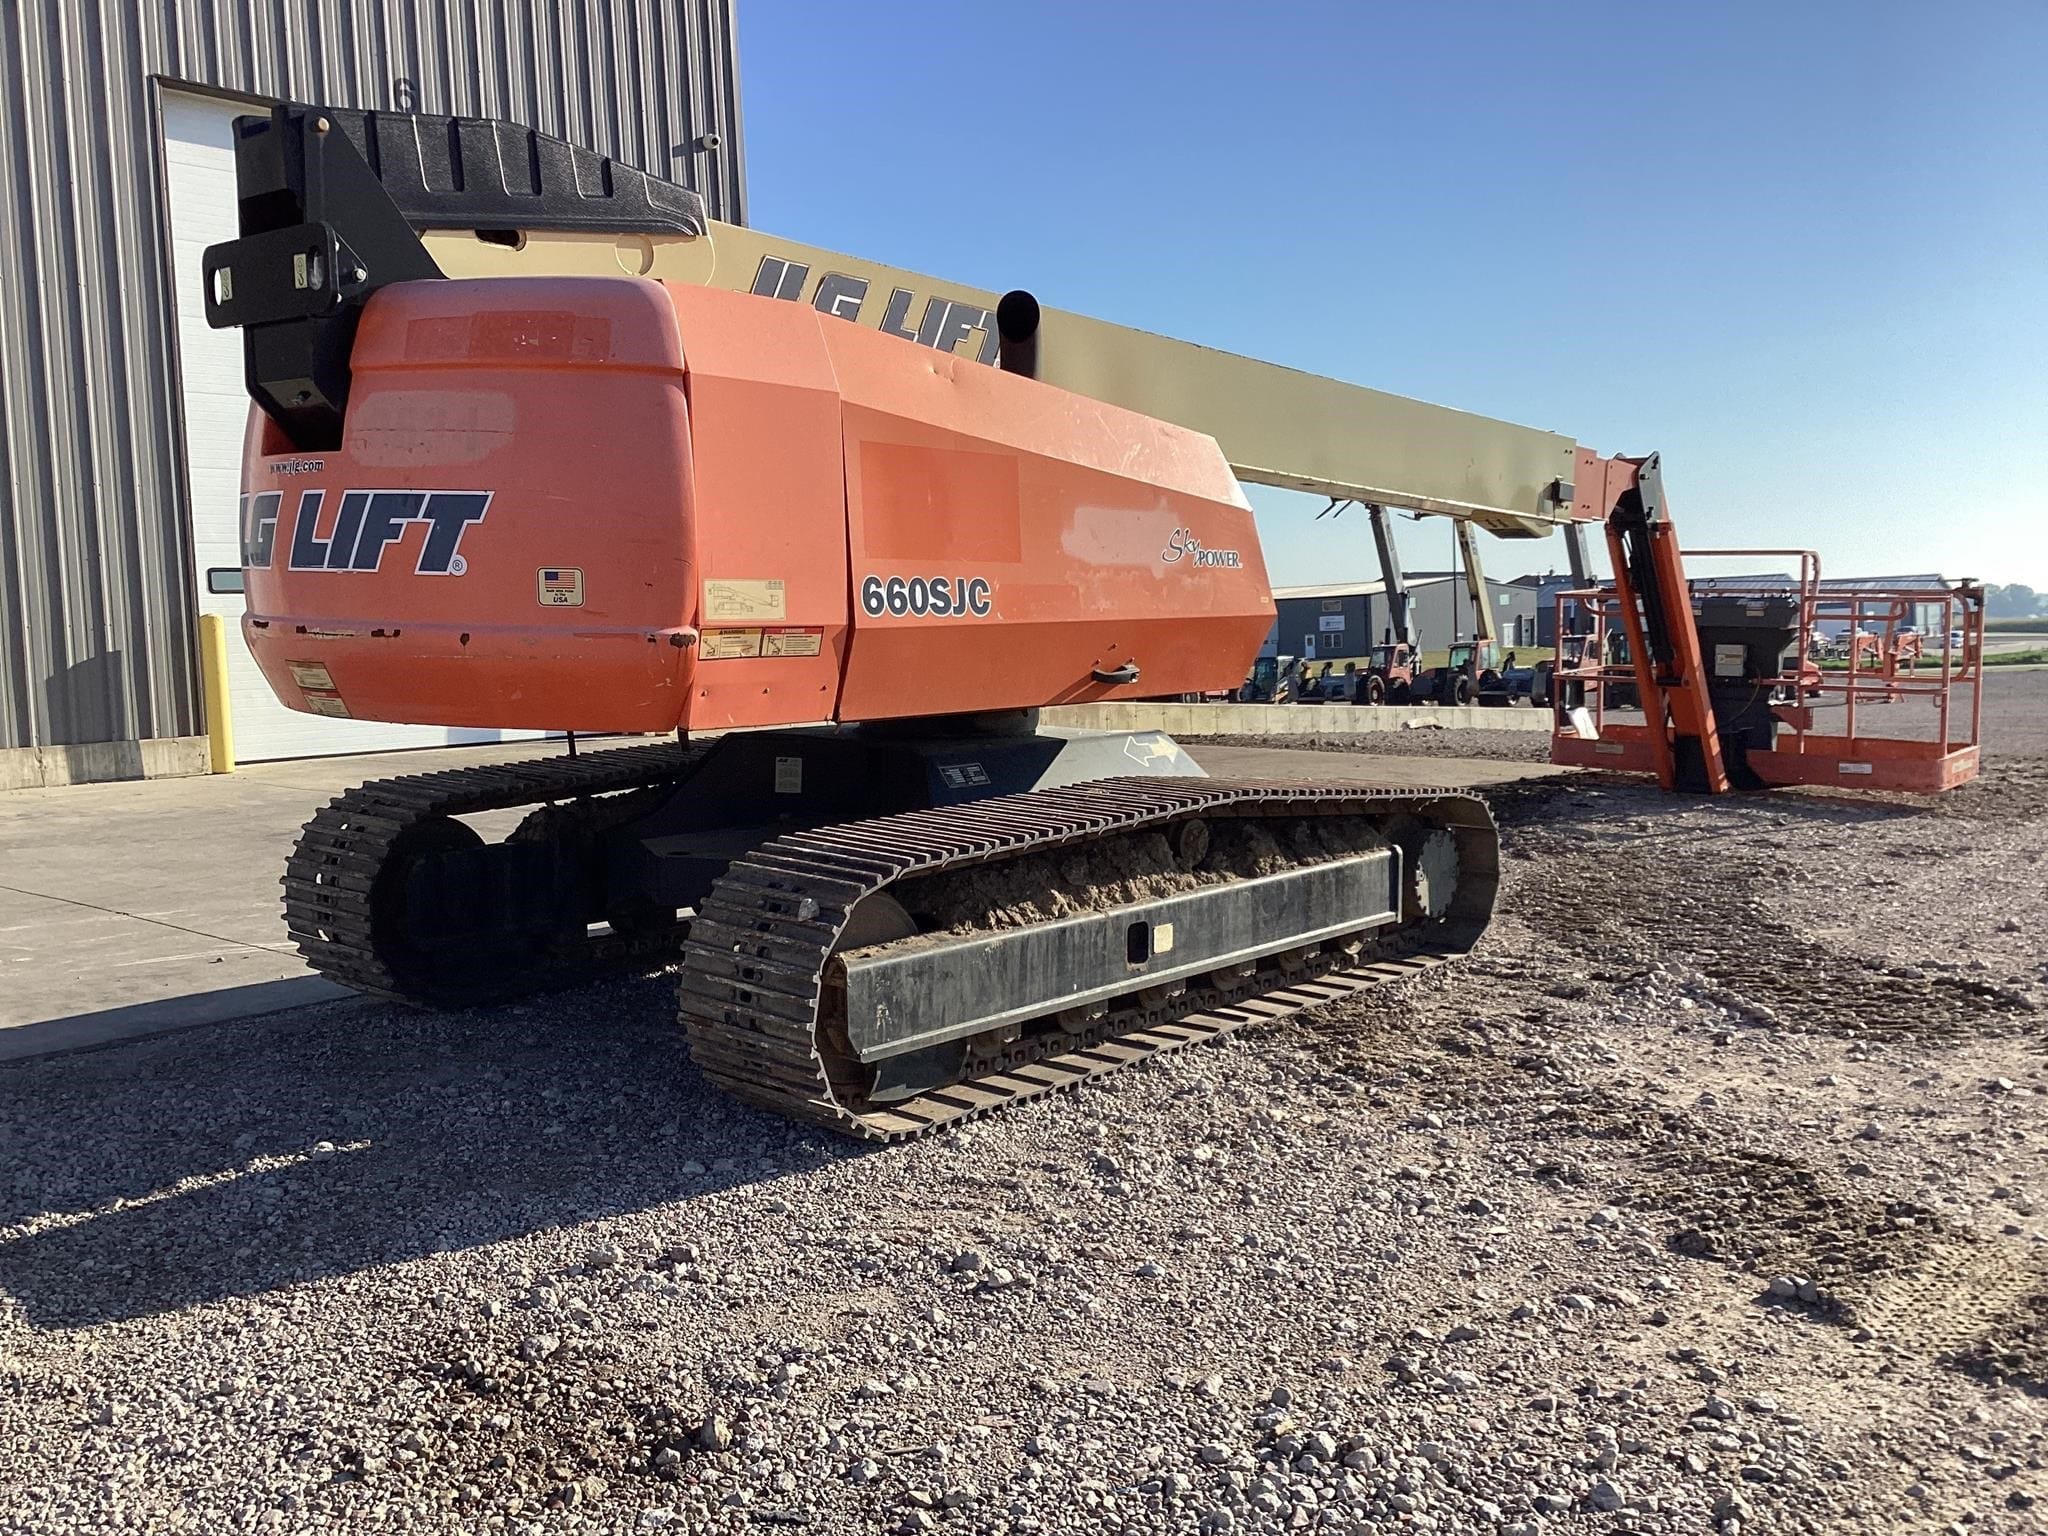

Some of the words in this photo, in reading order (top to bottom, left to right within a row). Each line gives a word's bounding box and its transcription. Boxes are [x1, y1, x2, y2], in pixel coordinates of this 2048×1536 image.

[394, 78, 417, 113] 6
[1198, 549, 1240, 568] POWER
[861, 574, 992, 618] 660SJC
